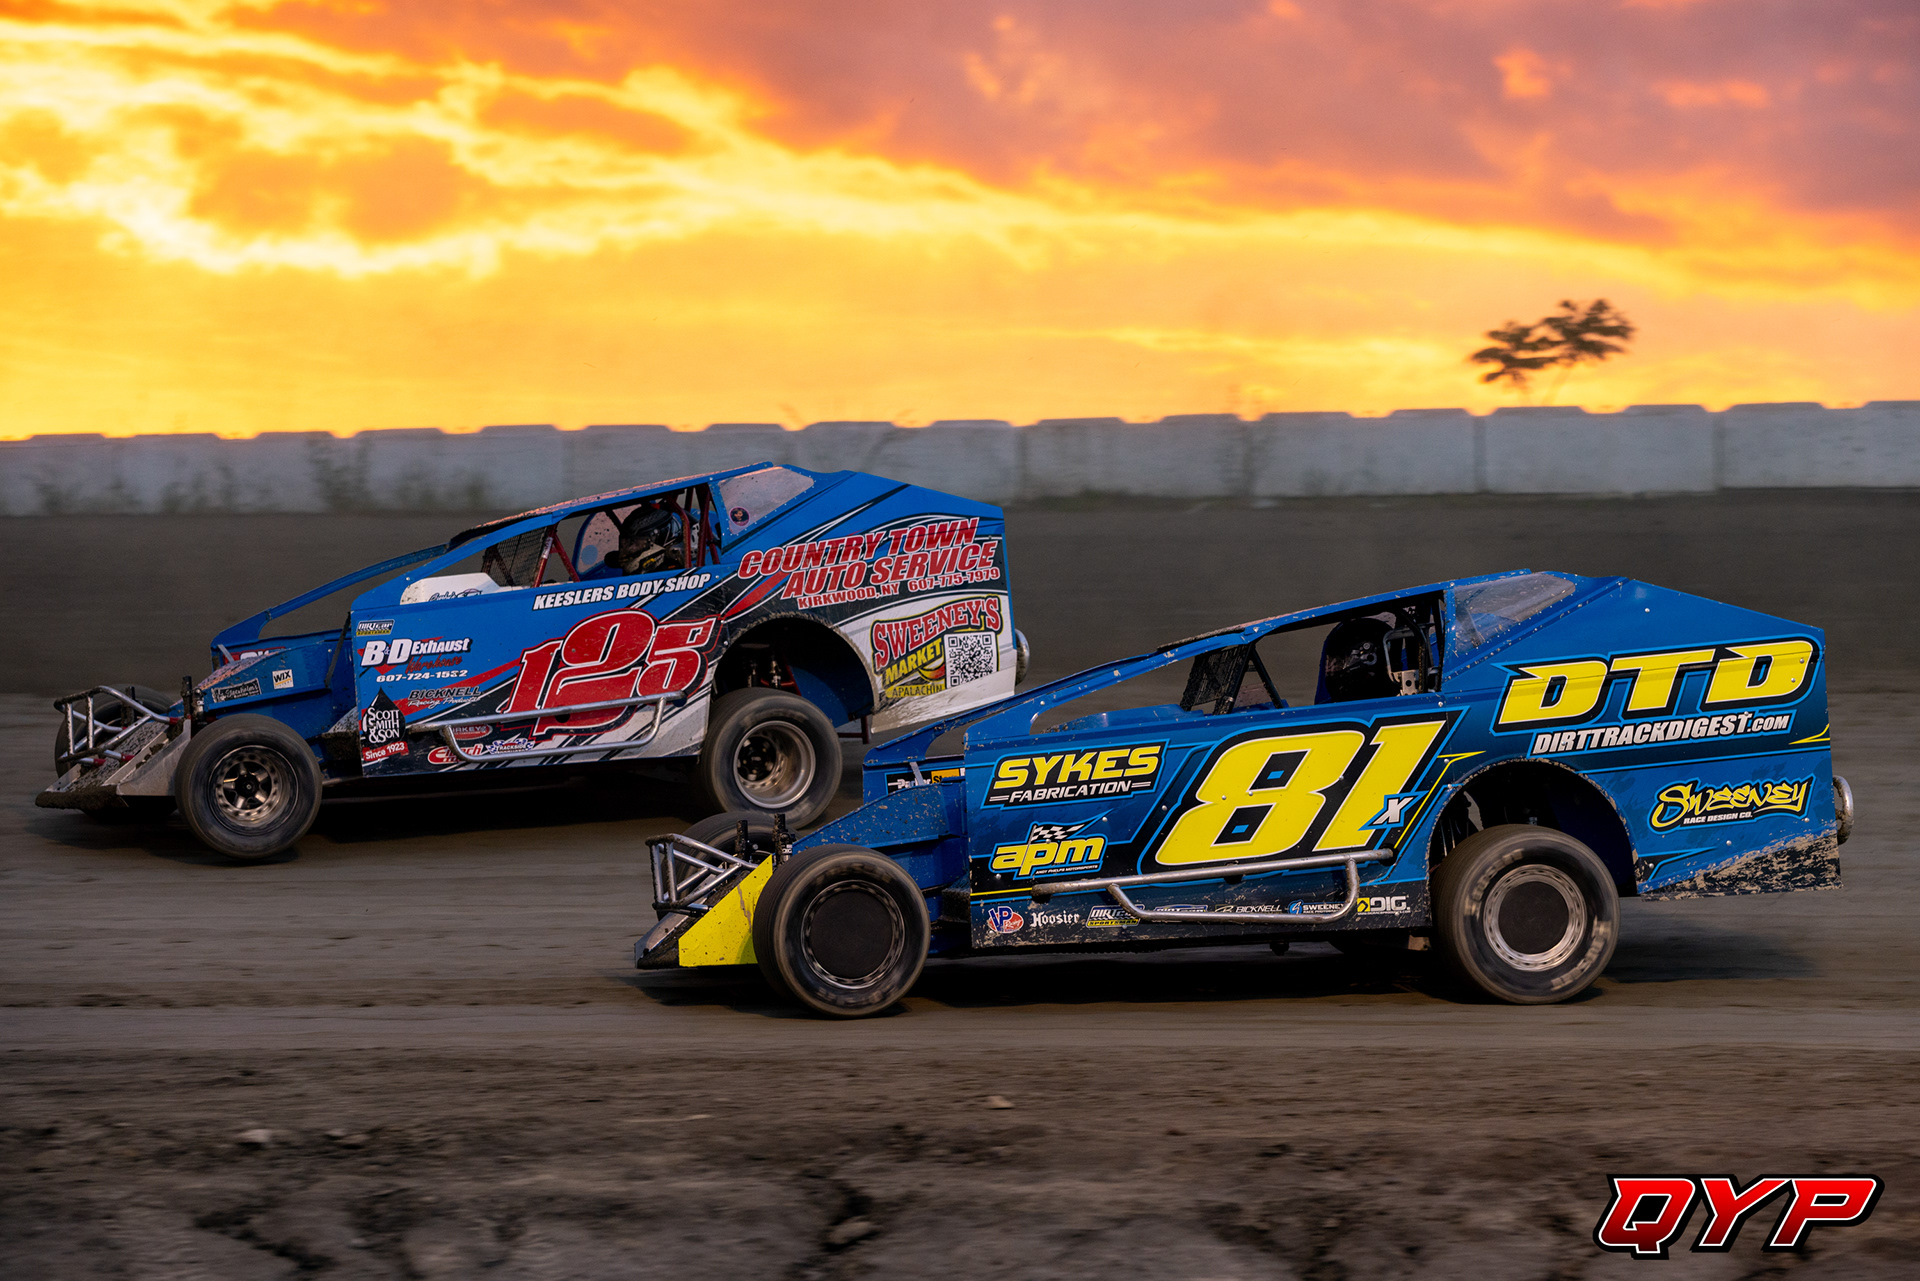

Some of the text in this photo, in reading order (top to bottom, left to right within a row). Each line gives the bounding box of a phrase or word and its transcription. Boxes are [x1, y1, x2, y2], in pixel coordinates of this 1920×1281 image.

[738, 517, 980, 579] COUNTRY TOWN
[781, 541, 998, 600] AUTO SERVICE
[797, 567, 1000, 610] KIRKWOOD, NY 607-775-7979
[533, 573, 711, 611] KEESLERS BODY SHOP
[872, 598, 1001, 669] SWEENEY'S
[273, 671, 291, 683] WIX
[405, 654, 463, 674] Warehouse
[496, 609, 718, 736] 125
[884, 638, 943, 686] MARKET
[408, 685, 483, 700] BICKNELL
[892, 684, 943, 697] APALACHIN
[1498, 640, 1814, 725] DTD
[365, 741, 406, 760] Since 1923
[993, 746, 1161, 790] SYKES
[1009, 781, 1132, 803] FABRICATION
[1154, 719, 1447, 866] 81
[1683, 811, 1753, 825] RACE DESIGN CO.
[992, 838, 1105, 876] apm
[988, 905, 1014, 933] VP
[1030, 910, 1080, 927] Hoosier
[1236, 904, 1283, 913] BICKNELL
